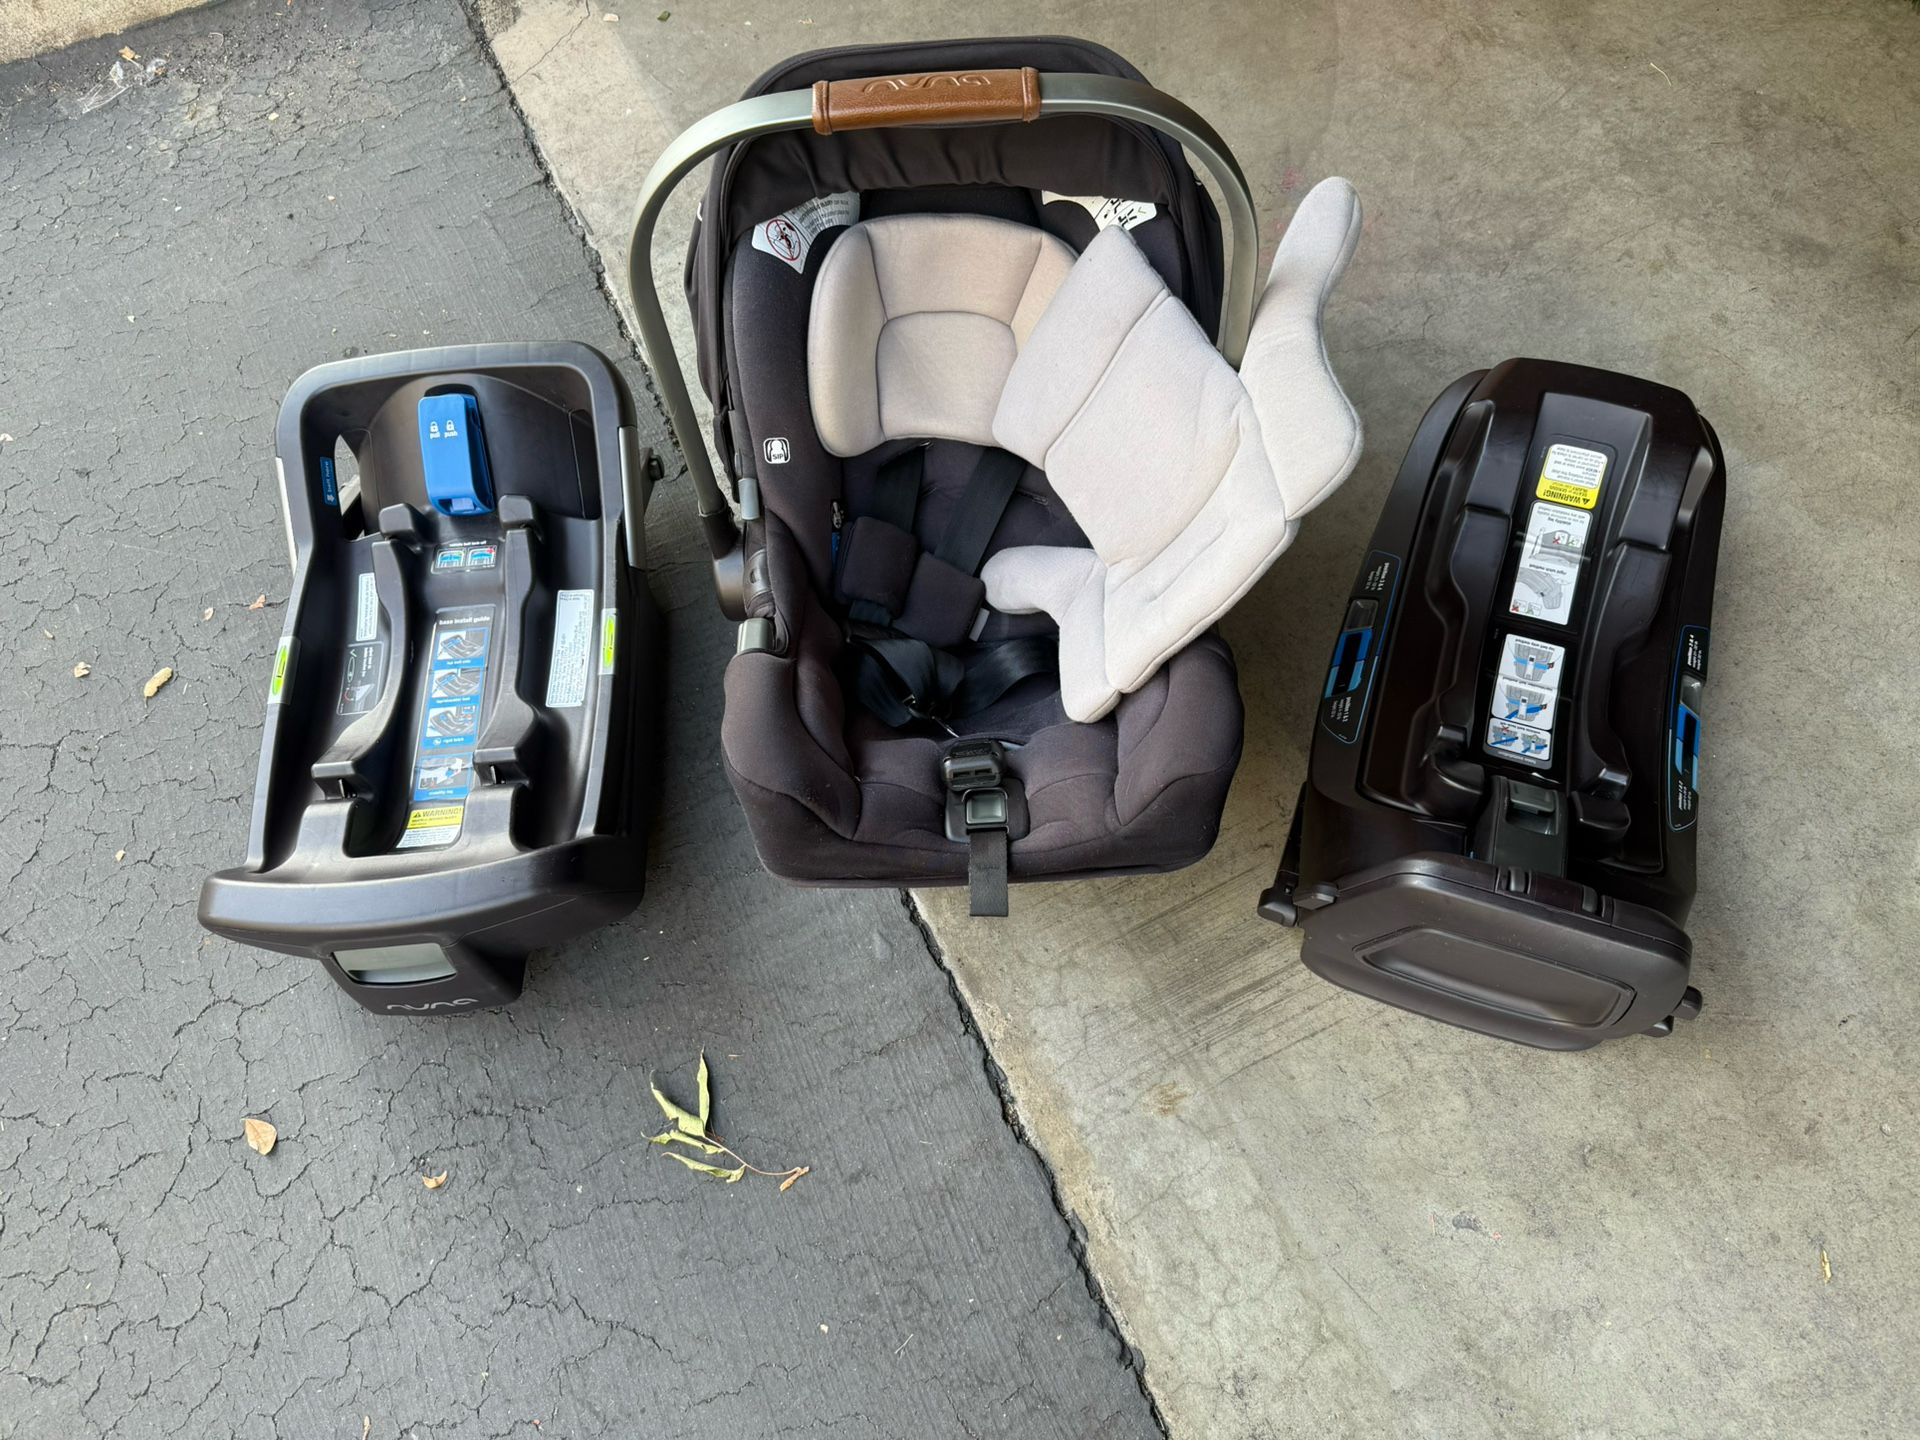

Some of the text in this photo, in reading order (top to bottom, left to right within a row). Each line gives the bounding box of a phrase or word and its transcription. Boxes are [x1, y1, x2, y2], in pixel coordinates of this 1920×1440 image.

[444, 431, 458, 439] push
[1543, 489, 1581, 504] WARNING!
[454, 617, 472, 625] install
[473, 615, 490, 623] guide
[422, 807, 462, 817] WARNING!
[387, 998, 480, 1010] nuna
